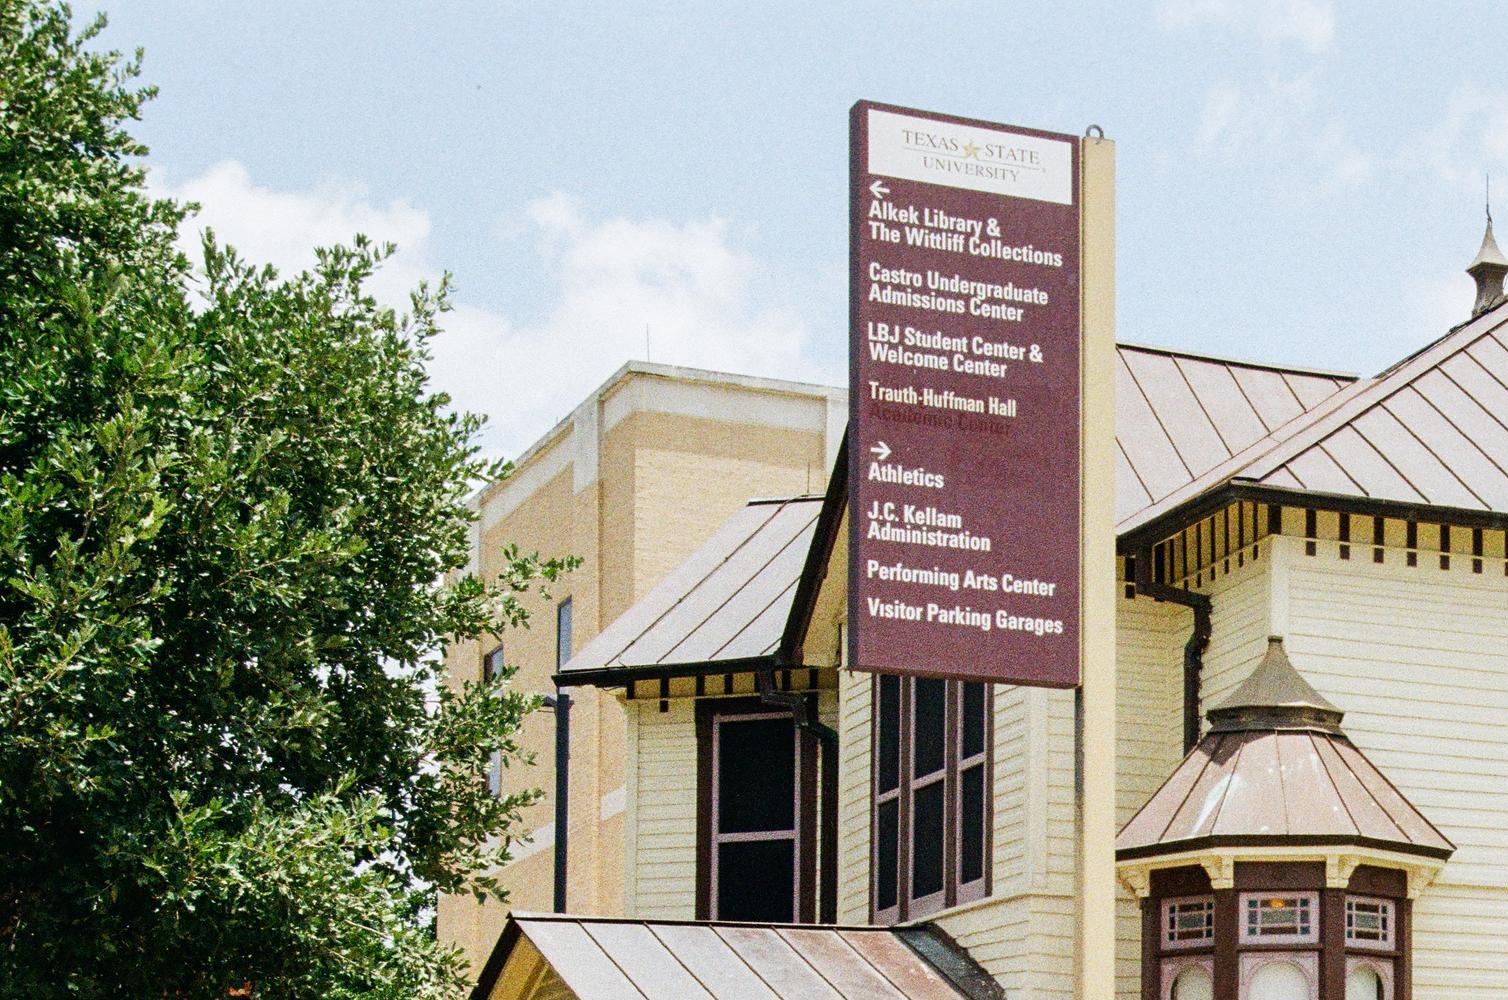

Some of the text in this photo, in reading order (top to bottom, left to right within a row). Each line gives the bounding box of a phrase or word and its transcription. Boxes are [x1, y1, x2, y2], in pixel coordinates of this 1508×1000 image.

[902, 128, 1040, 165] TEXAS STATE
[923, 156, 1020, 182] UNIVERSITY
[869, 200, 1001, 238] Alkek Library &
[869, 221, 1063, 267] The Wittliff Collections
[869, 262, 1049, 305] Castro Undergraduate
[869, 283, 1024, 321] Admissions Center
[868, 322, 1044, 364] LBJ Student Center &
[869, 342, 1007, 377] Welcome Center
[868, 381, 1017, 417] Trauth-Huffman Hall
[868, 462, 944, 488] Athletics
[867, 501, 962, 529] J.C. Kellam
[867, 521, 991, 551] Administration
[867, 559, 1055, 597] Performing Arts Center
[867, 597, 1063, 636] Visitor Parking Garages
